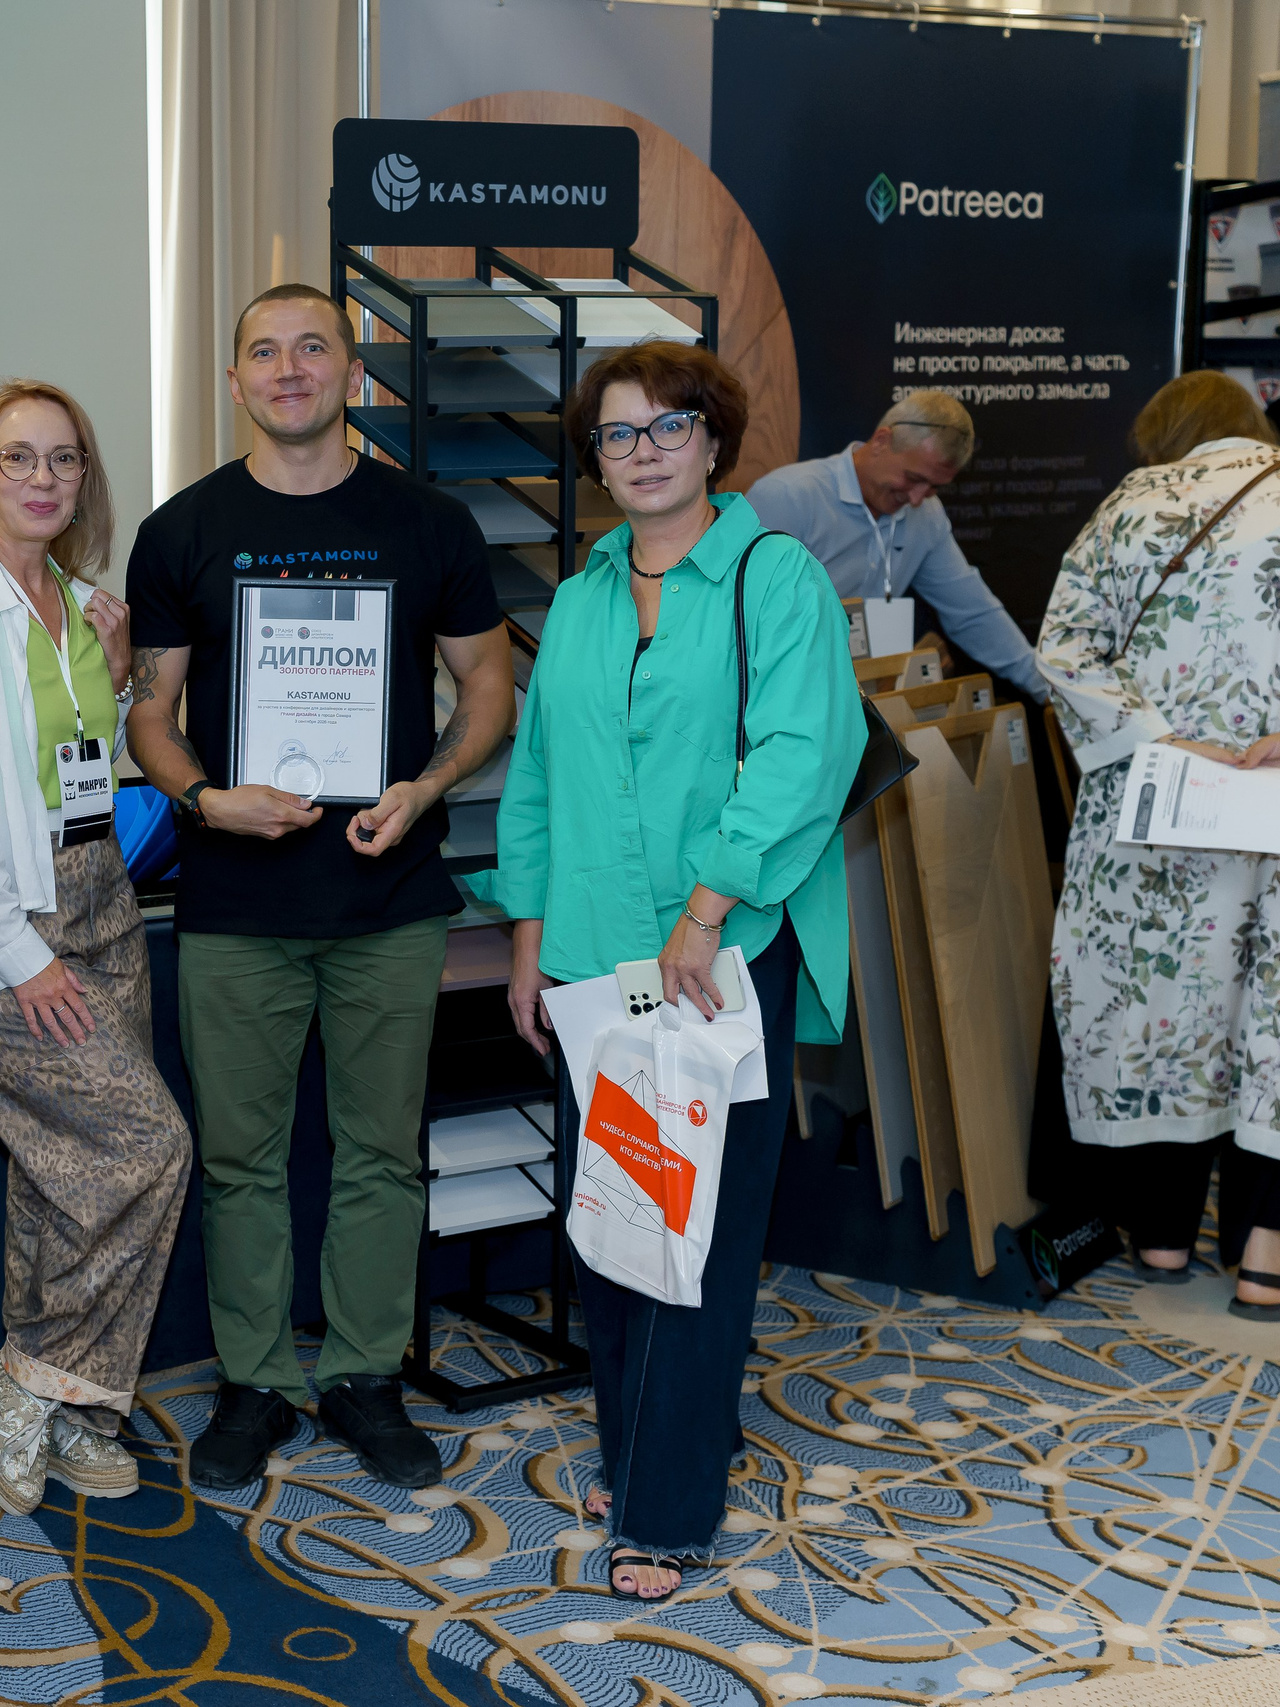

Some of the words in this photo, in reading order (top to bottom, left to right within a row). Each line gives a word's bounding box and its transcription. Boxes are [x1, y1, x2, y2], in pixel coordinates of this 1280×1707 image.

[429, 182, 607, 206] KASTAMONU
[899, 181, 1044, 219] Patreeca
[894, 321, 1006, 347] Инженерная
[1008, 325, 1065, 347] доска:
[893, 356, 915, 372] не
[919, 355, 980, 376] просто
[982, 355, 1069, 376] покрытие,
[1071, 355, 1082, 371] а
[1084, 353, 1130, 371] часть
[1036, 383, 1110, 400] замысла
[258, 550, 379, 566] KASTAMONU
[258, 646, 377, 669] ДИПЛОМ
[279, 667, 327, 675] ЗОЛОТОГО
[329, 668, 376, 676] ПАРТНЕРА
[287, 691, 351, 700] KASTAMONU
[78, 777, 108, 792] МАКРУС
[656, 1104, 685, 1117] ИТЕКТОРОВ
[600, 1120, 626, 1139] ЧУДЕСА
[620, 1144, 633, 1157] КТО
[574, 1191, 607, 1211] unionda.ru
